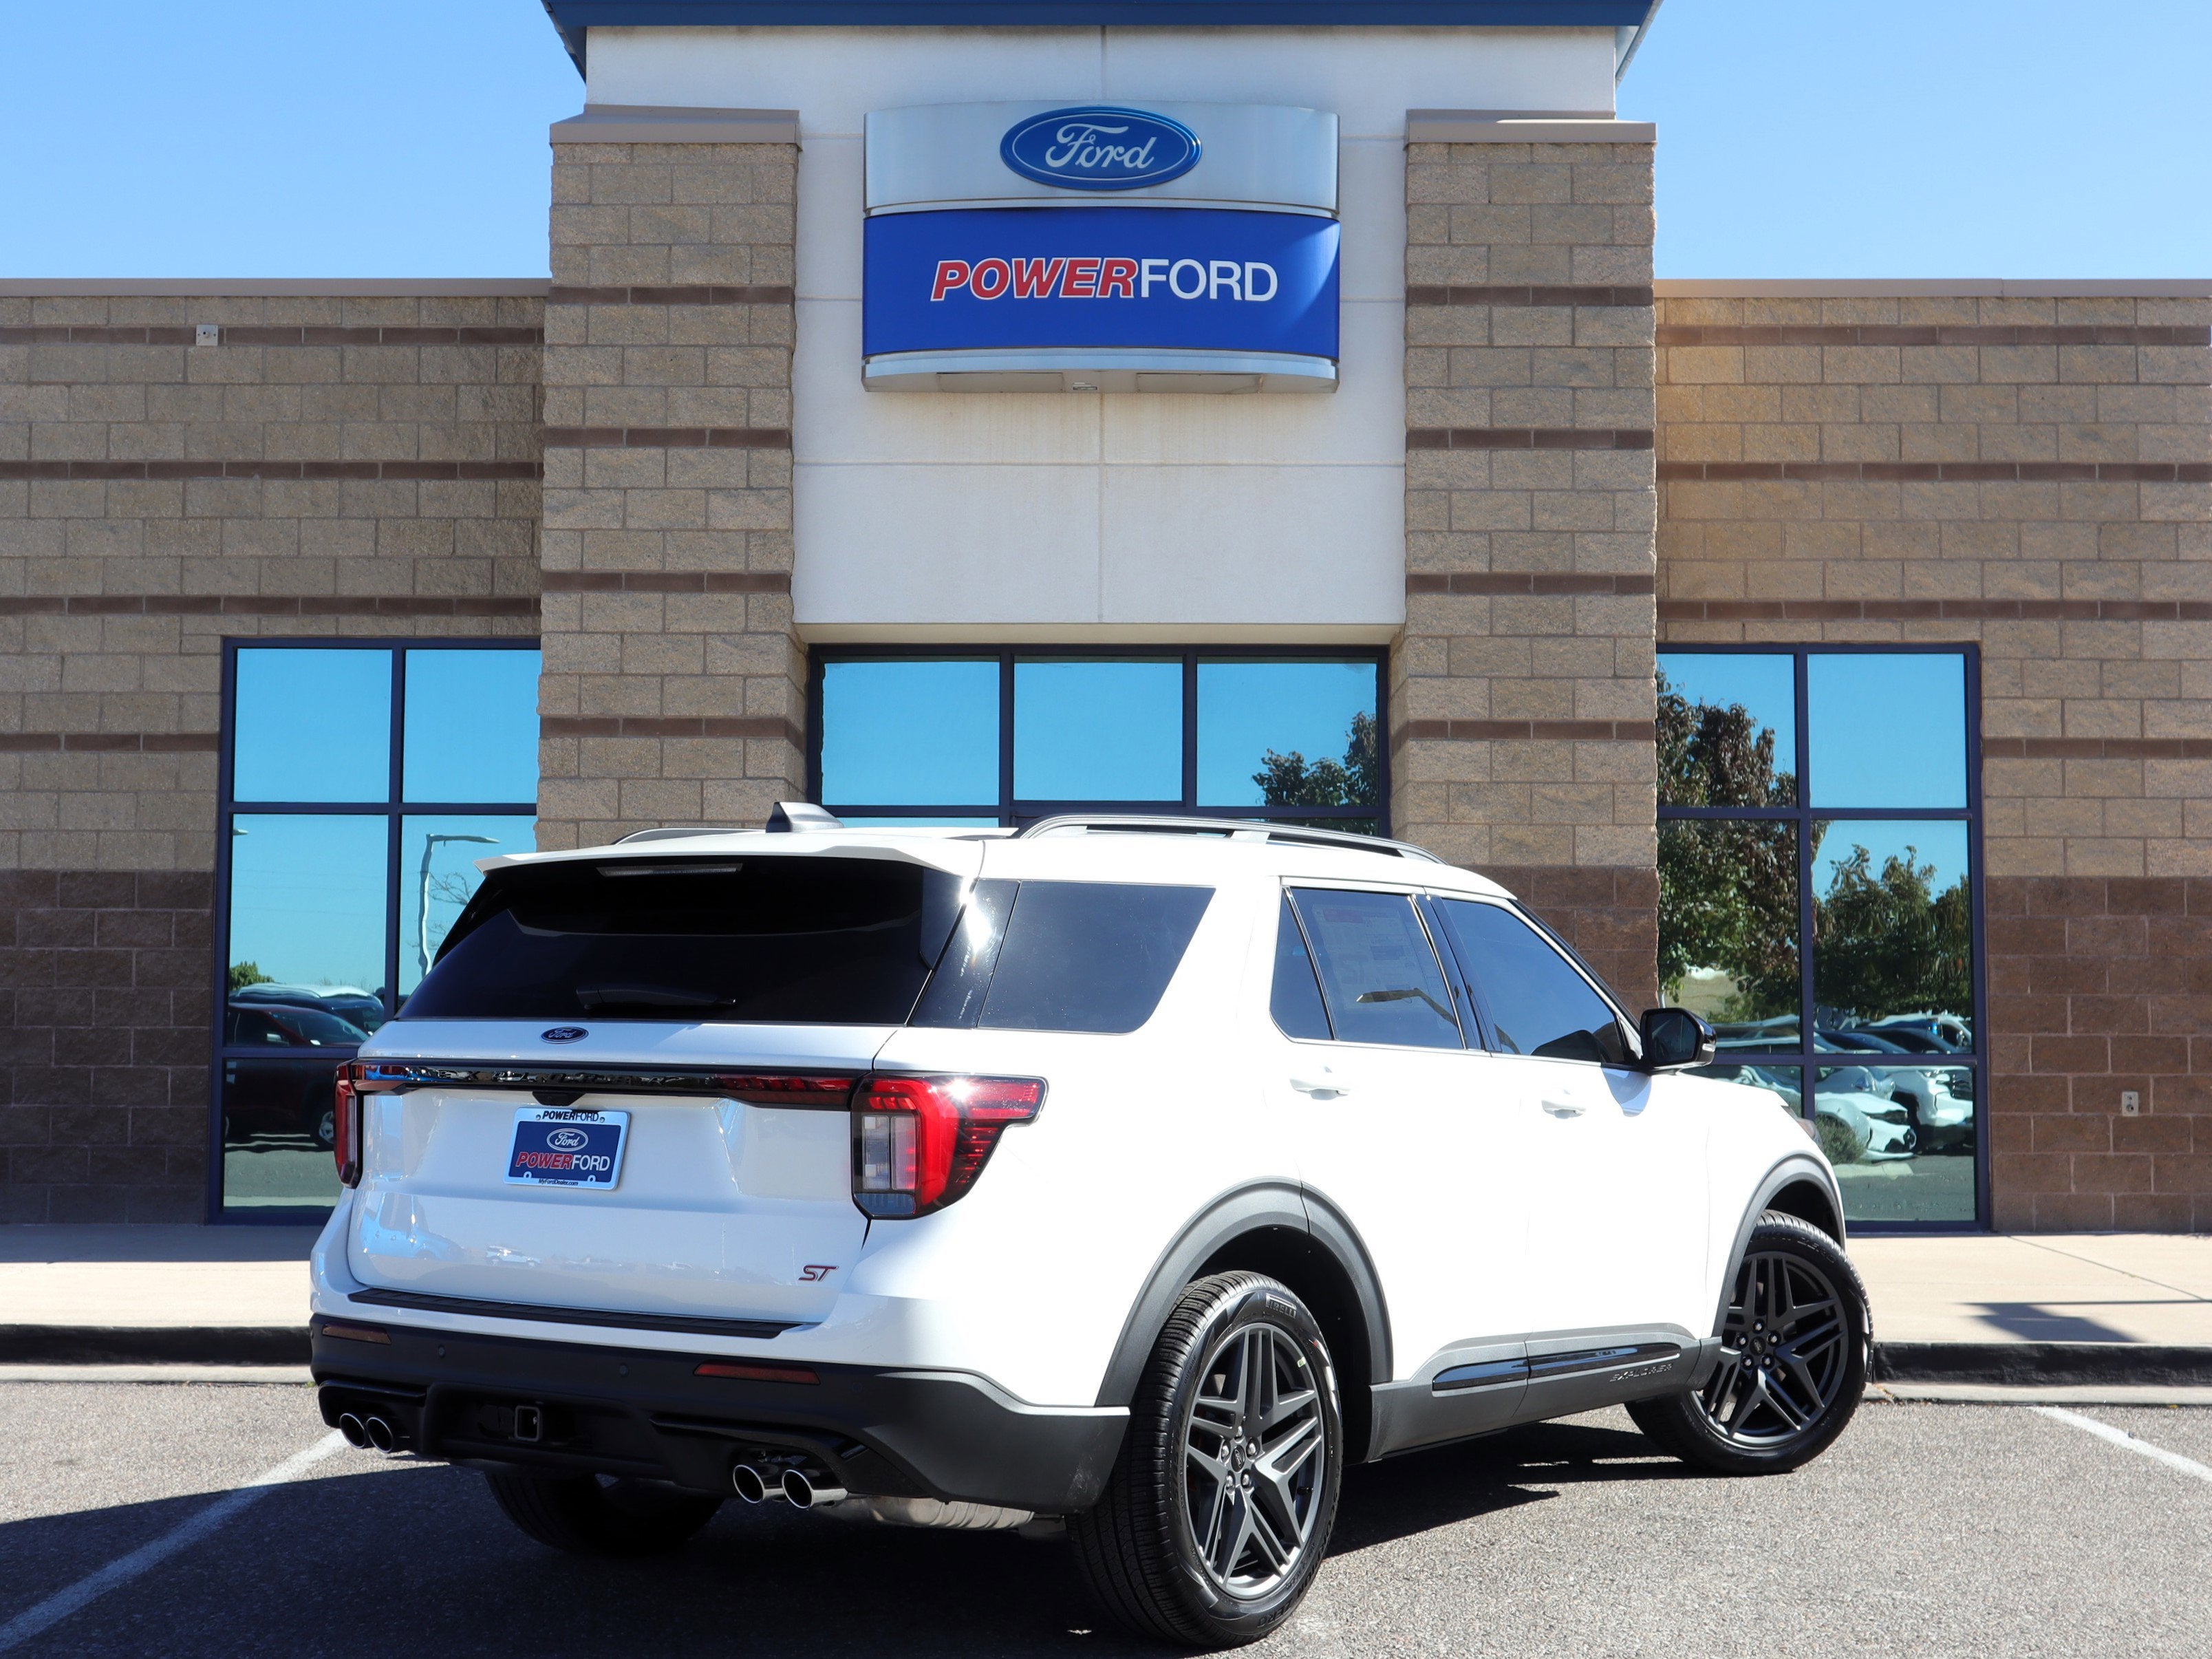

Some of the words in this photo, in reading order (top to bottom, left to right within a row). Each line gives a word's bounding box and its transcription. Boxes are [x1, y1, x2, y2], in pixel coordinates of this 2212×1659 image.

[1045, 122, 1157, 170] Ford
[548, 1027, 577, 1039] Ford
[542, 1110, 599, 1122] POWERFORD
[555, 1131, 579, 1147] Ford
[516, 1150, 610, 1171] POWERFORD
[797, 1265, 839, 1282] ST
[1265, 1293, 1297, 1319] PIRELLI
[1609, 1363, 1673, 1382] EXPLORER
